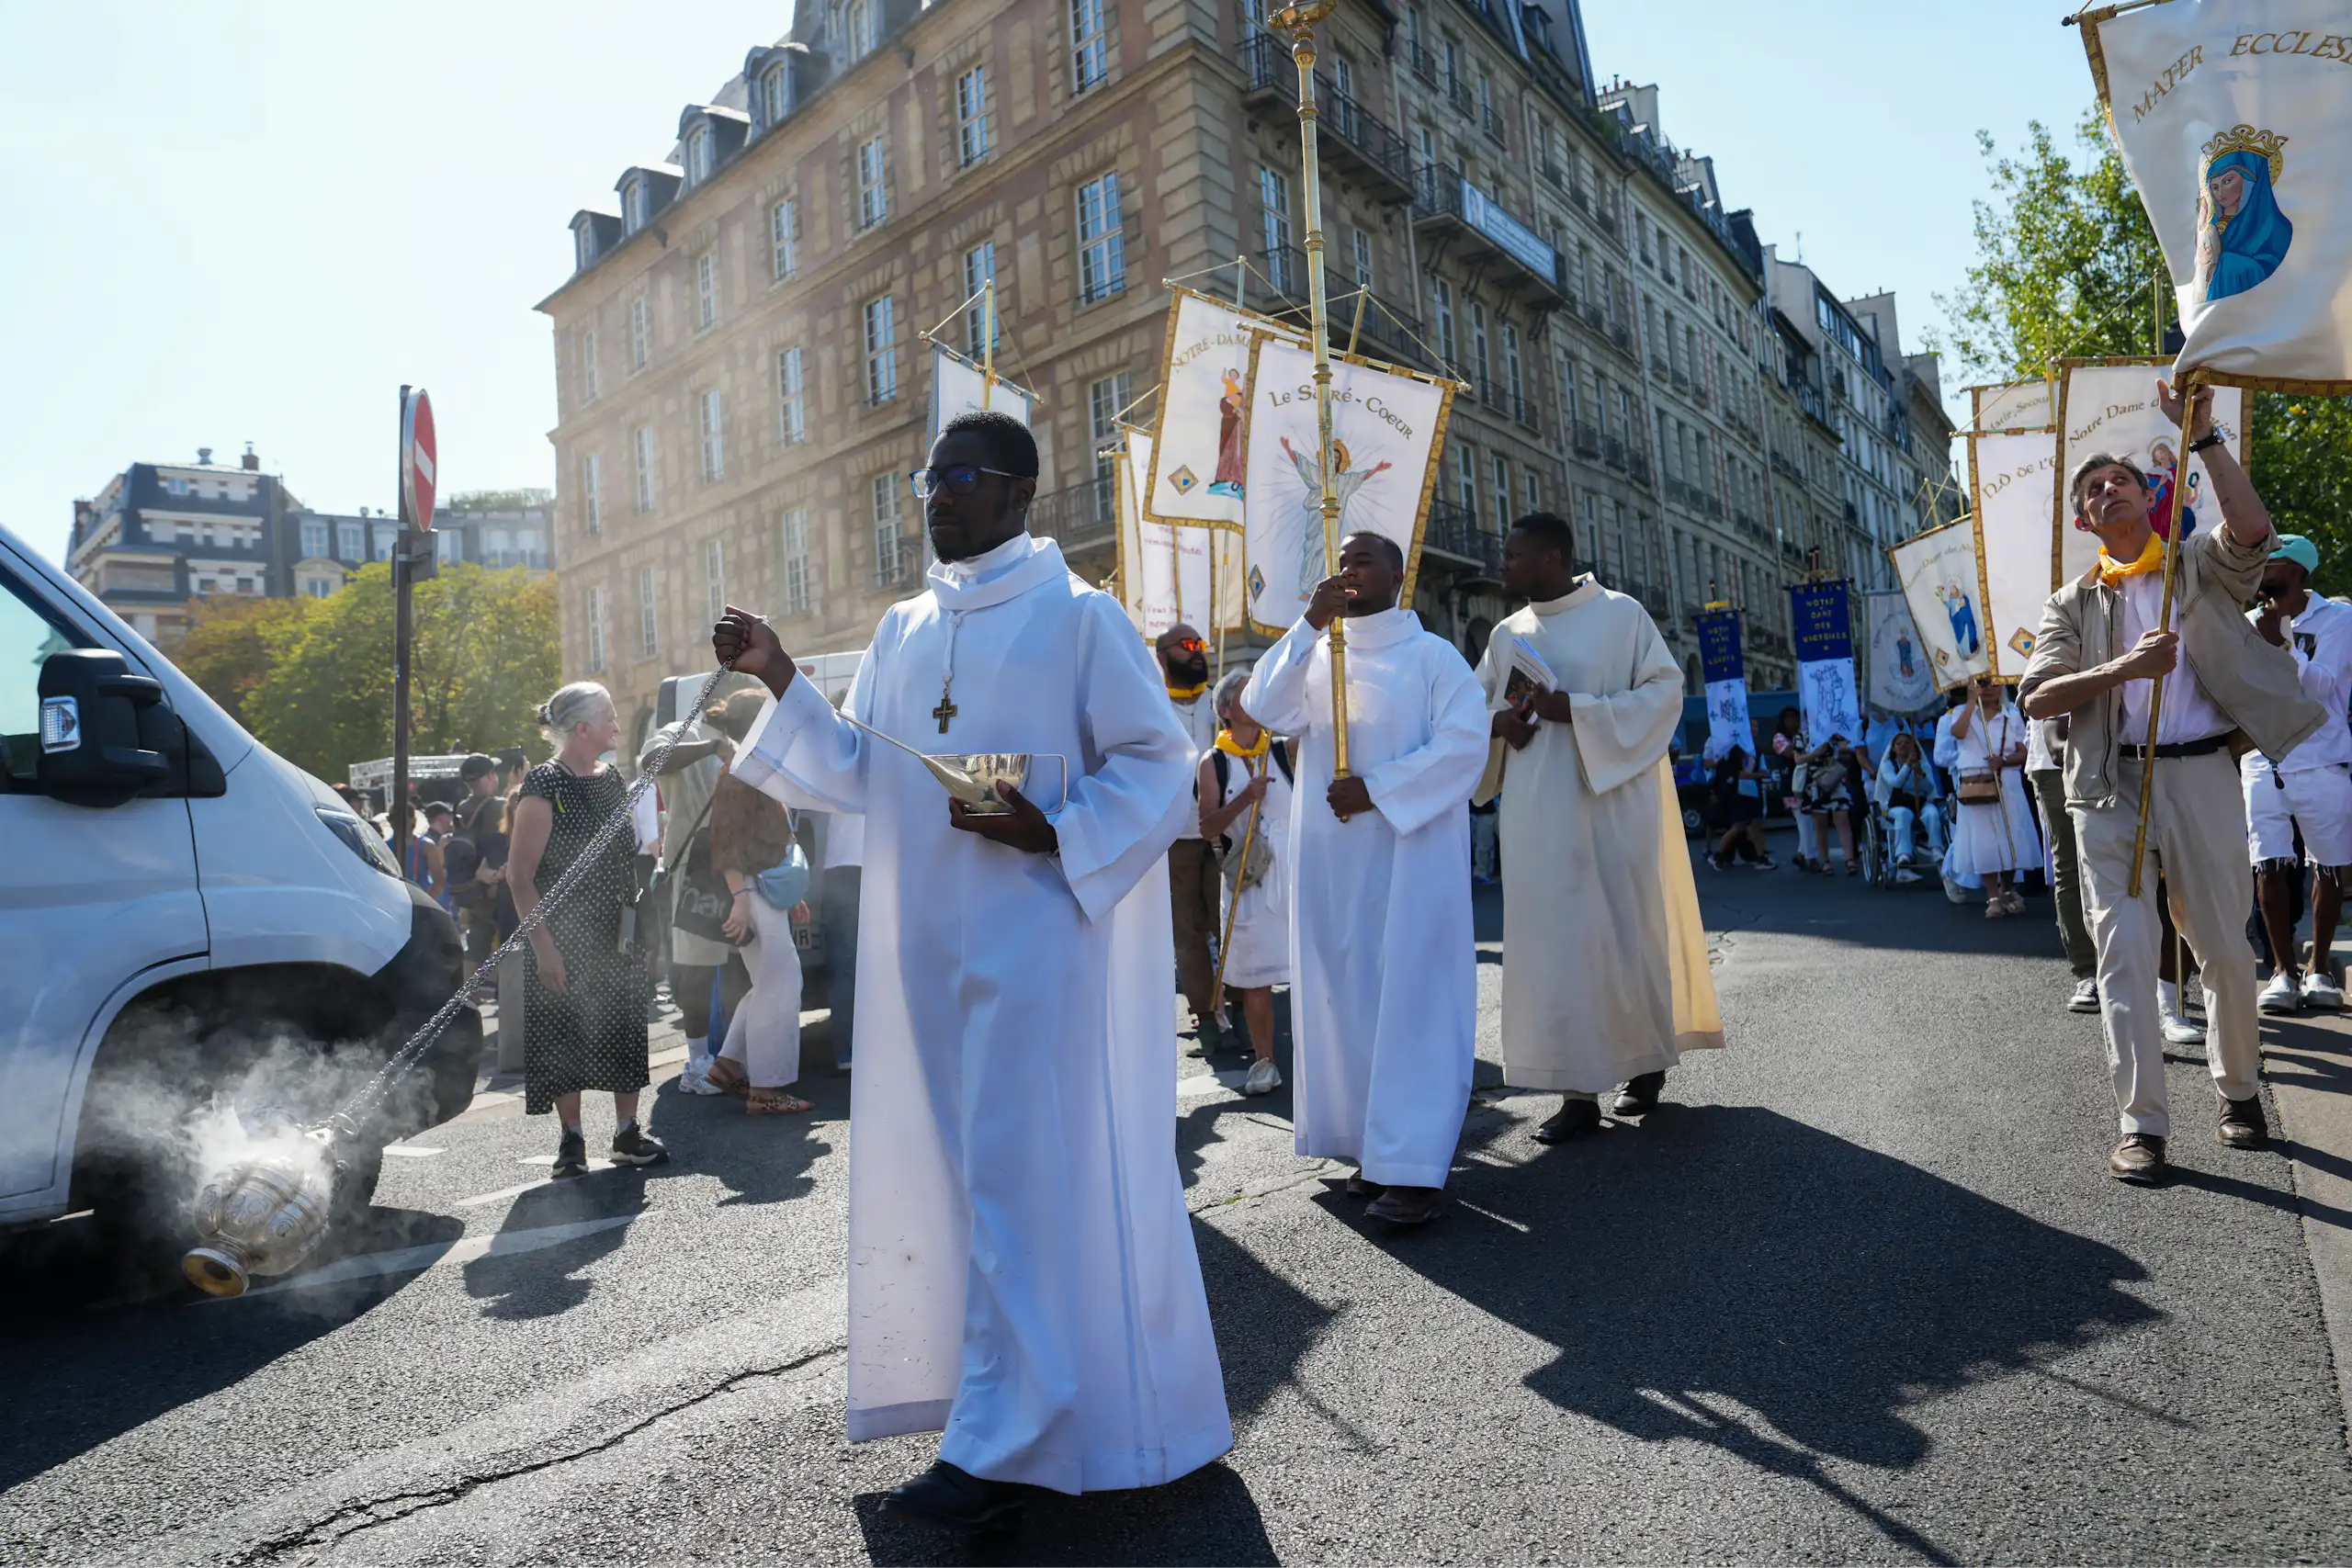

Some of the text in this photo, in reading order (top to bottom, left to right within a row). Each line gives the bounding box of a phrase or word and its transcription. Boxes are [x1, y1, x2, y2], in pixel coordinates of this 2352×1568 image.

[2131, 30, 2352, 125] MATER ECCLES
[1268, 390, 1291, 407] Le
[2068, 415, 2102, 449] Notre
[2106, 402, 2145, 420] Dame
